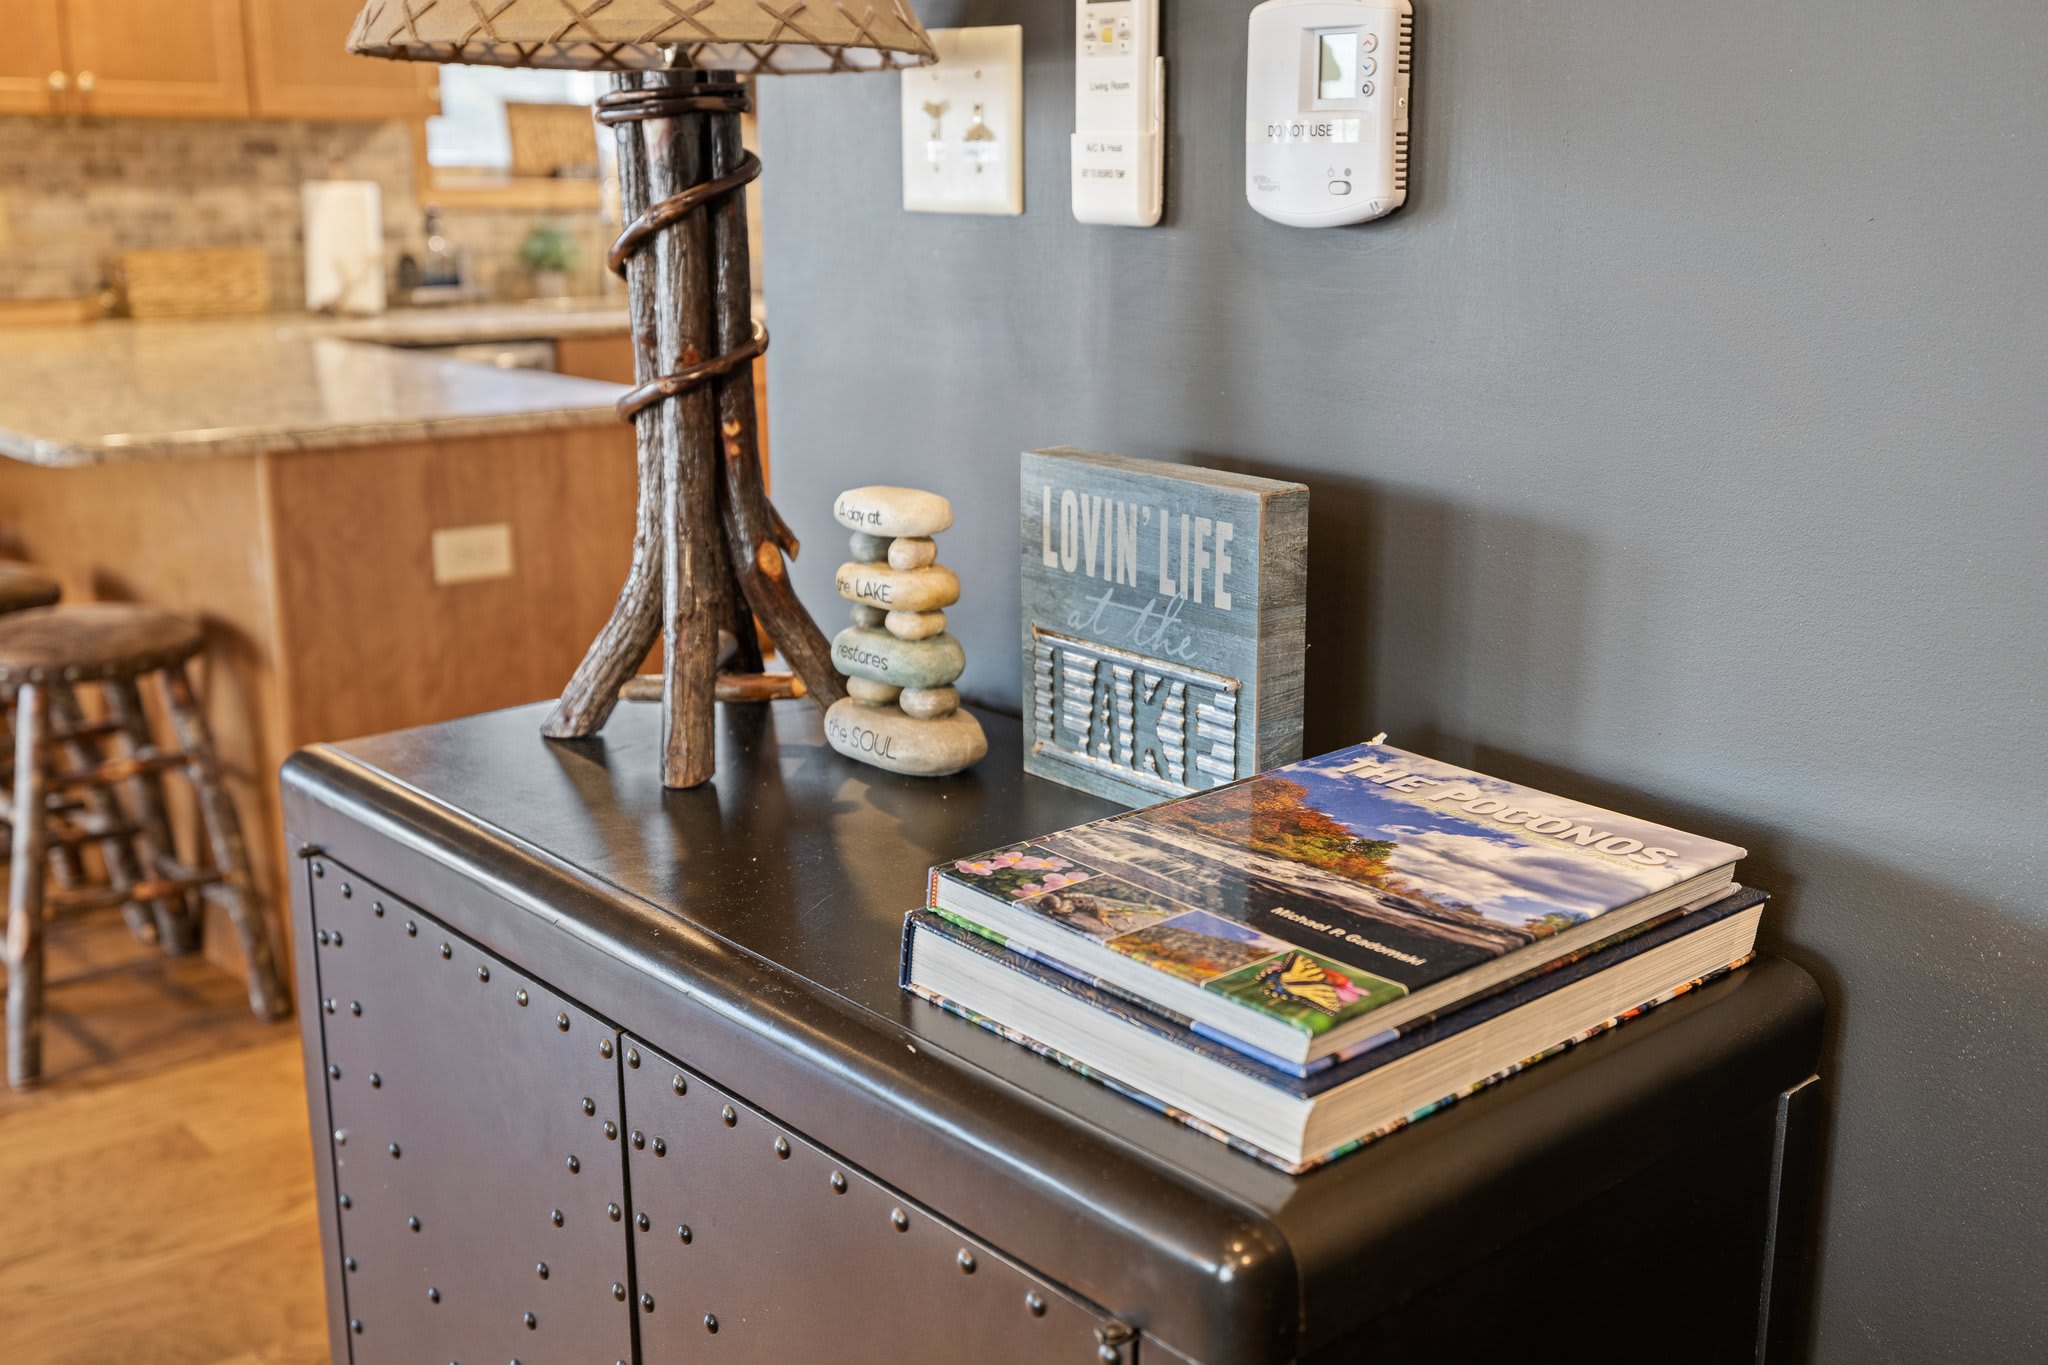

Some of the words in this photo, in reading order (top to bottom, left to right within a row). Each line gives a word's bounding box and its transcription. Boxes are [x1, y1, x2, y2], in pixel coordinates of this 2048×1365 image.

[1267, 124, 1282, 137] DO
[1284, 124, 1306, 137] NOT
[1309, 123, 1334, 137] USE
[847, 505, 865, 527] day
[867, 510, 882, 526] at
[1042, 485, 1150, 588] LOVIN'
[1159, 509, 1234, 611] LIFE
[855, 578, 893, 604] LAKE
[1066, 587, 1114, 636] at
[1124, 590, 1199, 661] the
[836, 643, 889, 671] restores
[850, 726, 897, 760] SOUL
[1050, 647, 1217, 792] LAKE
[1336, 756, 1440, 794] THE
[1428, 781, 1680, 866] POCONOS
[1269, 906, 1334, 932] Michael
[1344, 933, 1428, 967] Gadomski
